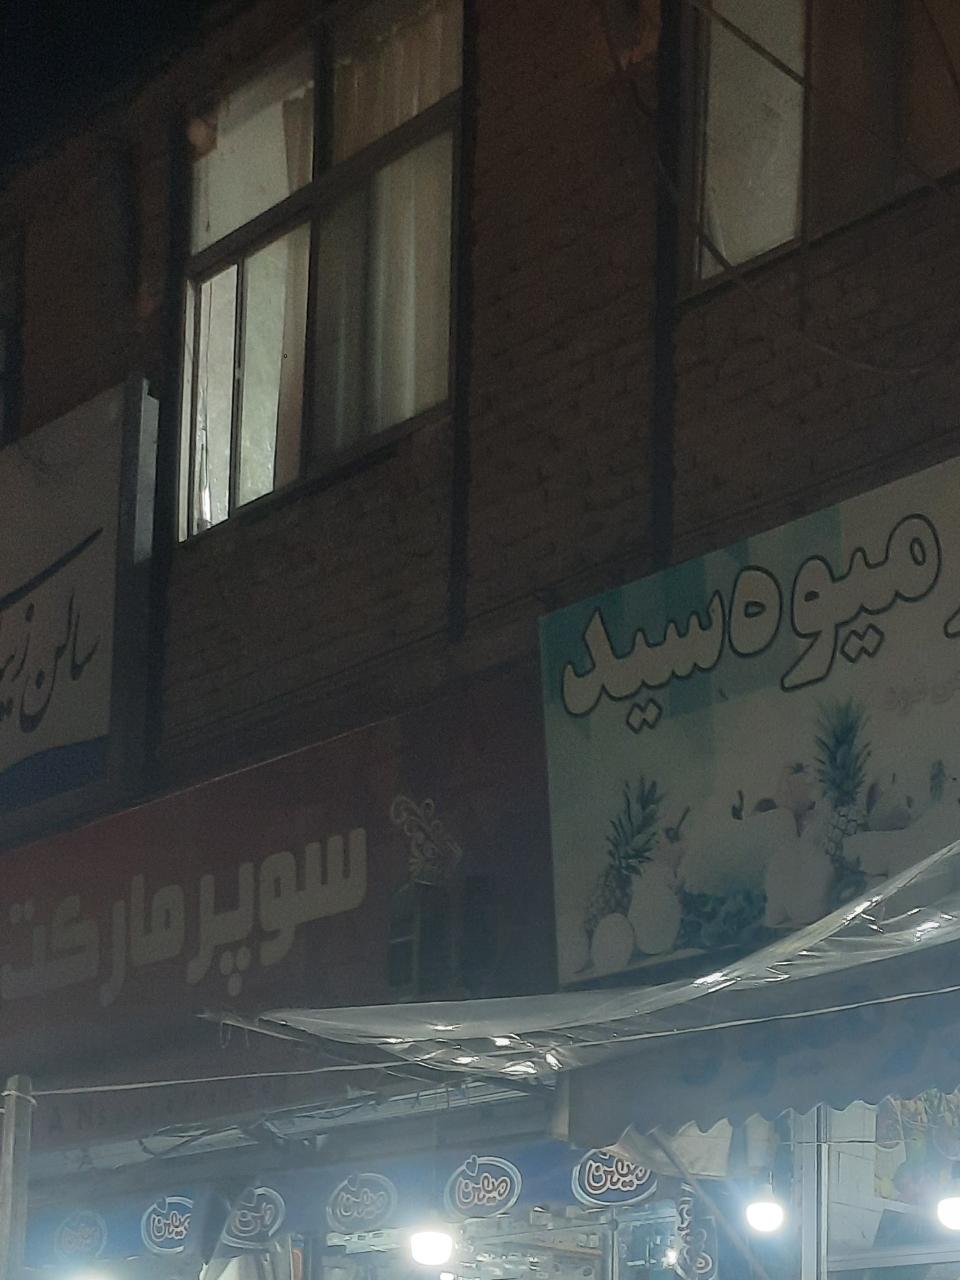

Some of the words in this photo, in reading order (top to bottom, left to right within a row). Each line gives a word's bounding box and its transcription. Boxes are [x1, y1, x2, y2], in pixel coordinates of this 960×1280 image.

[728, 512, 943, 692] میوه
[0, 873, 186, 1008] مارکت
[186, 827, 367, 997] سوپر
